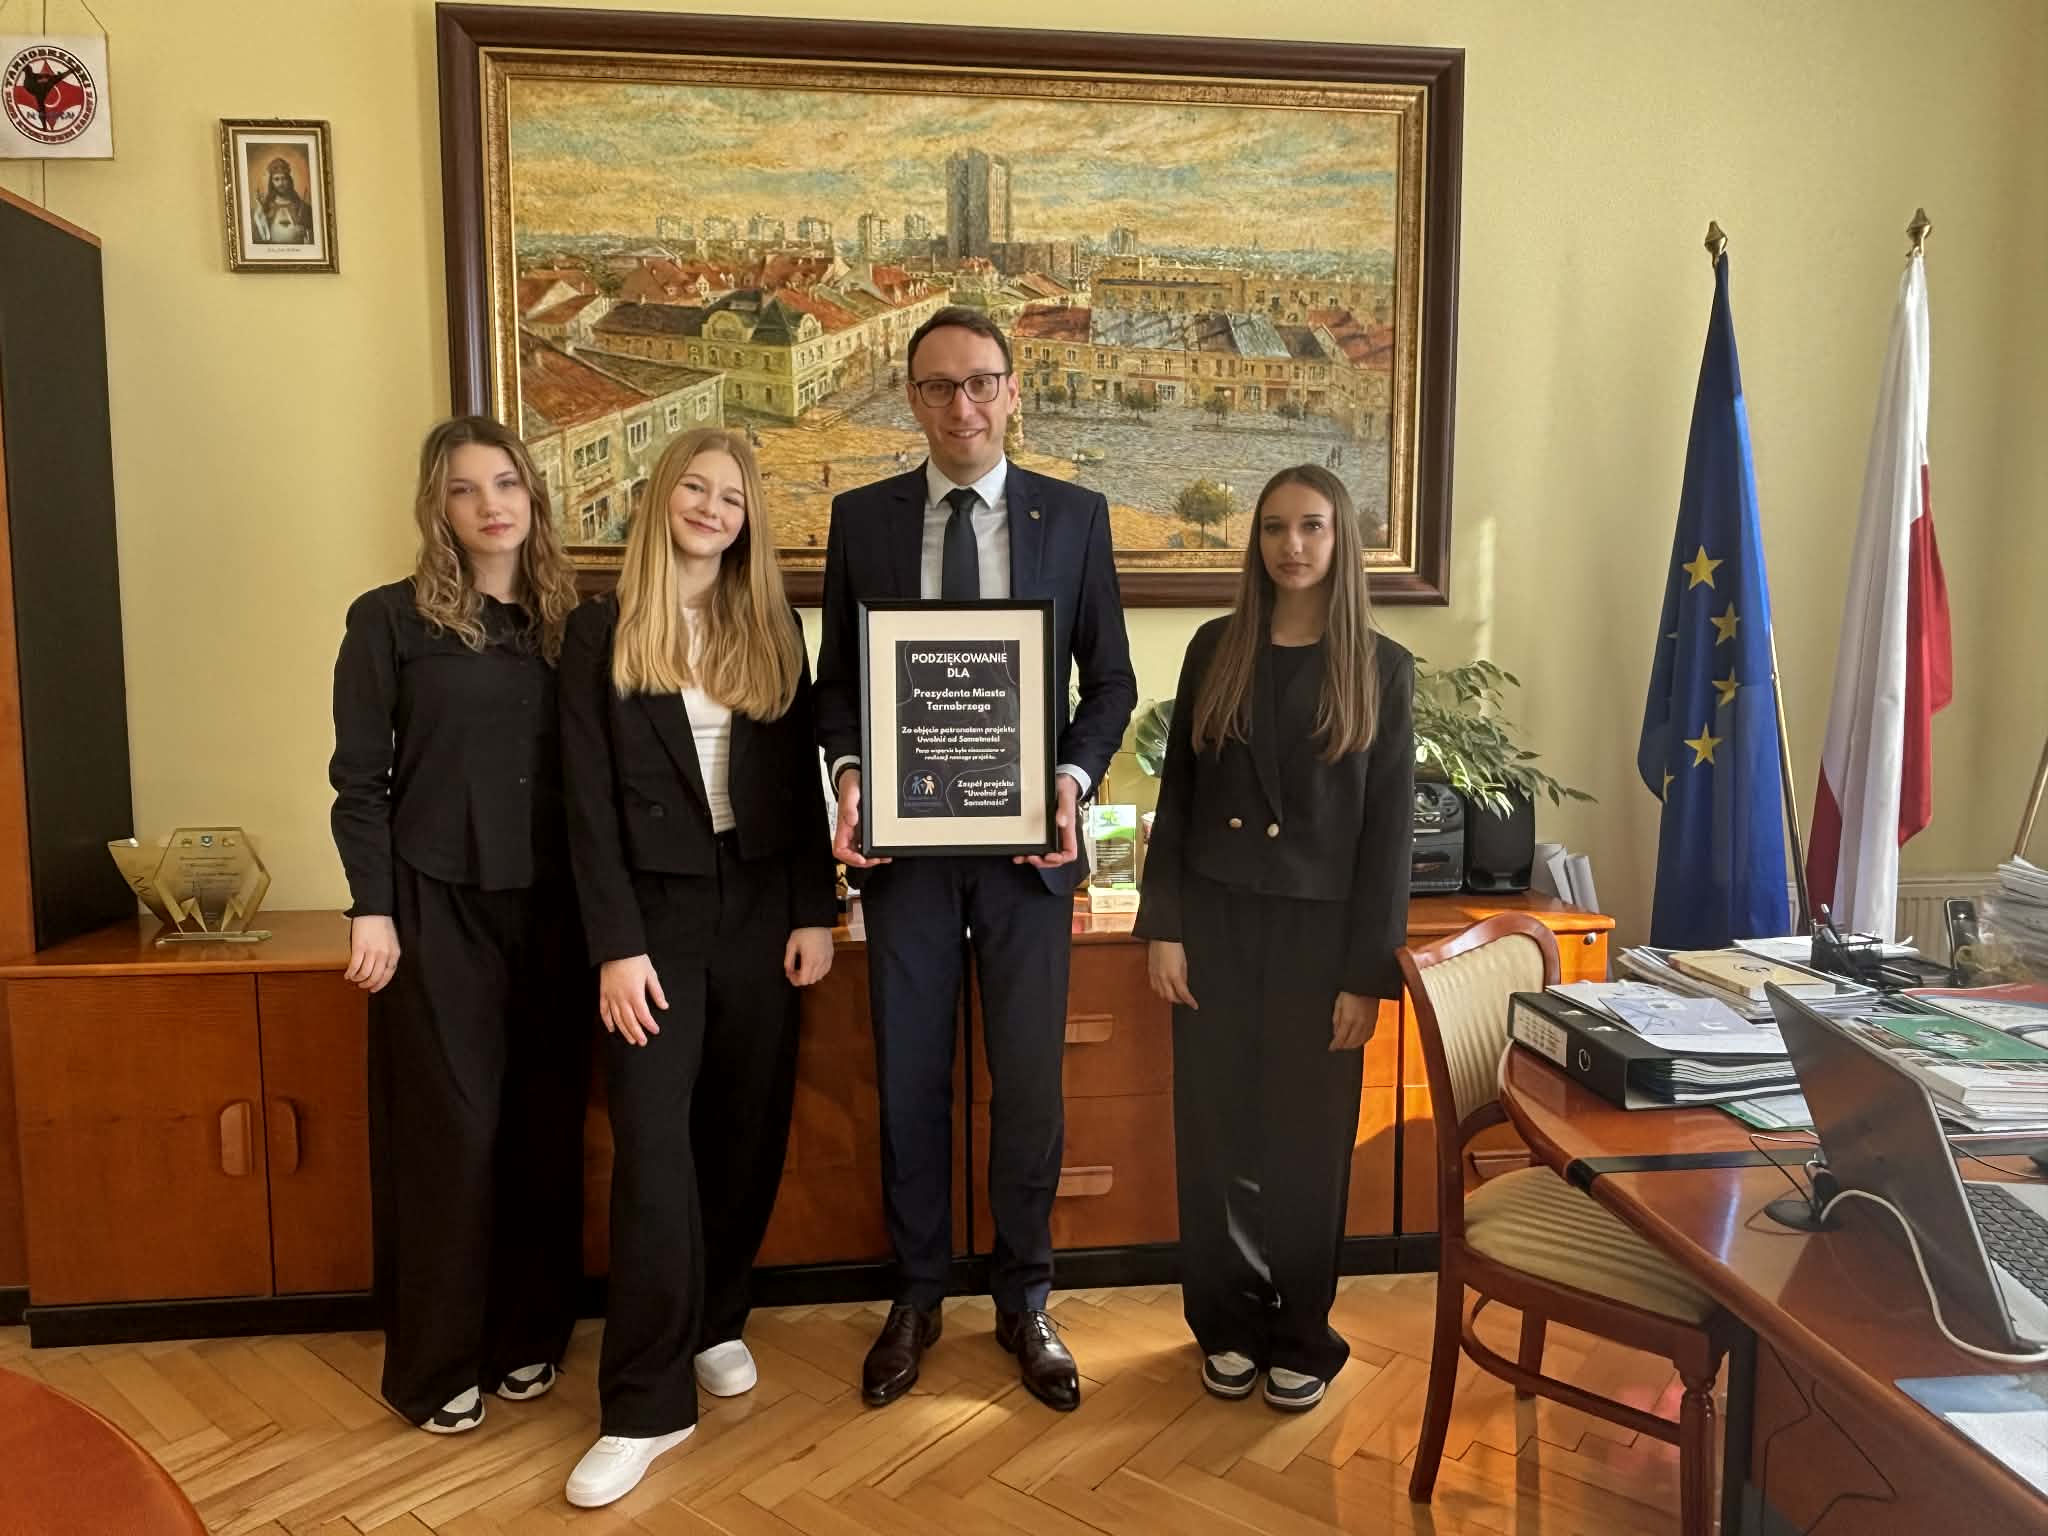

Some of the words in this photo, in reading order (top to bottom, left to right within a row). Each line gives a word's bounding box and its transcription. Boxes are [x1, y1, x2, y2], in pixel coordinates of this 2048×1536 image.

[911, 653, 1008, 665] PODZIĘKOWANIE
[947, 667, 970, 678] DLA
[913, 687, 971, 700] Prezydenta
[972, 687, 1006, 697] Miasta
[926, 701, 991, 712] Tarnobrzega
[901, 726, 912, 734] Za
[913, 725, 939, 735] objęcie
[940, 726, 983, 735] patronatem
[984, 725, 1016, 735] projektu
[917, 735, 946, 743] Uwolnić
[947, 735, 957, 743] od
[957, 780, 982, 789] Zespół
[983, 779, 1015, 789] projektu
[997, 788, 1008, 797] od
